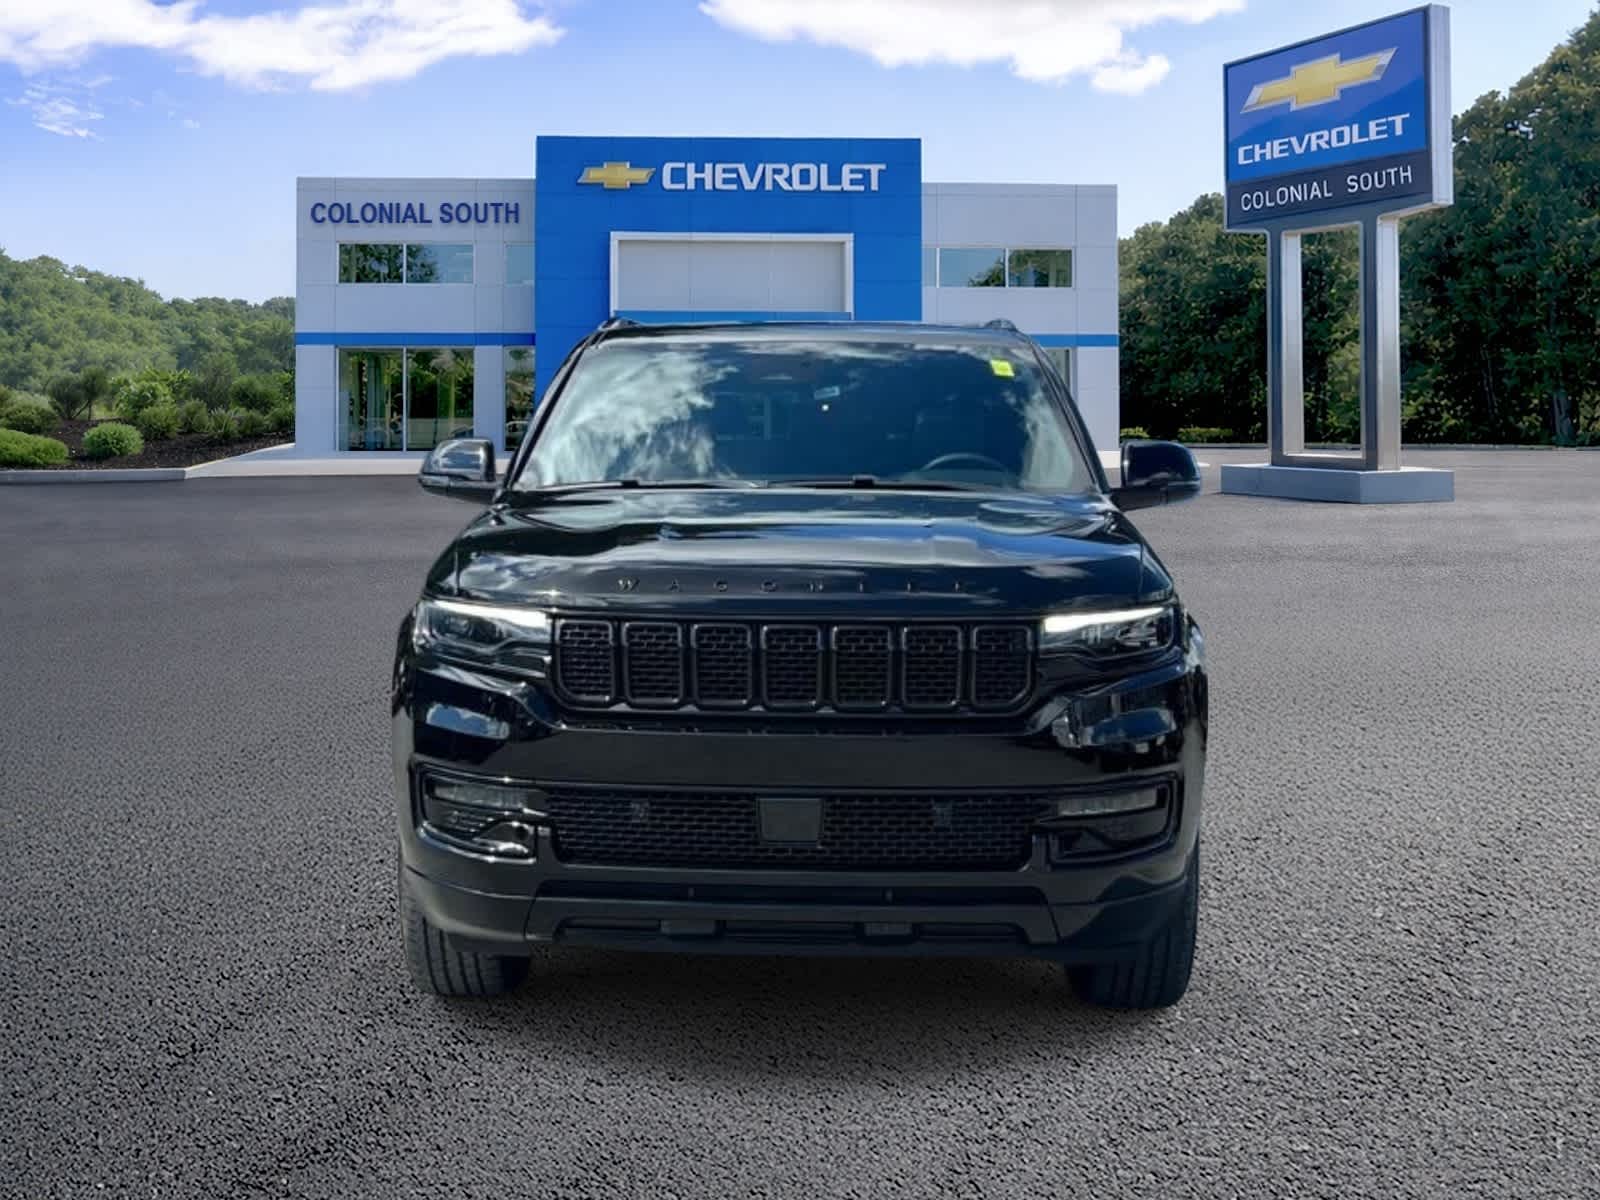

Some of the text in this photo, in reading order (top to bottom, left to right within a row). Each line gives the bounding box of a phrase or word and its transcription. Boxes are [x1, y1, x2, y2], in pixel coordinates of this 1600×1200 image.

[1237, 112, 1410, 165] CHEVROLET
[661, 161, 887, 192] CHEVROLET
[1240, 165, 1413, 211] COLONIAL SOUTH
[310, 202, 520, 224] COLONIAL SOUTH
